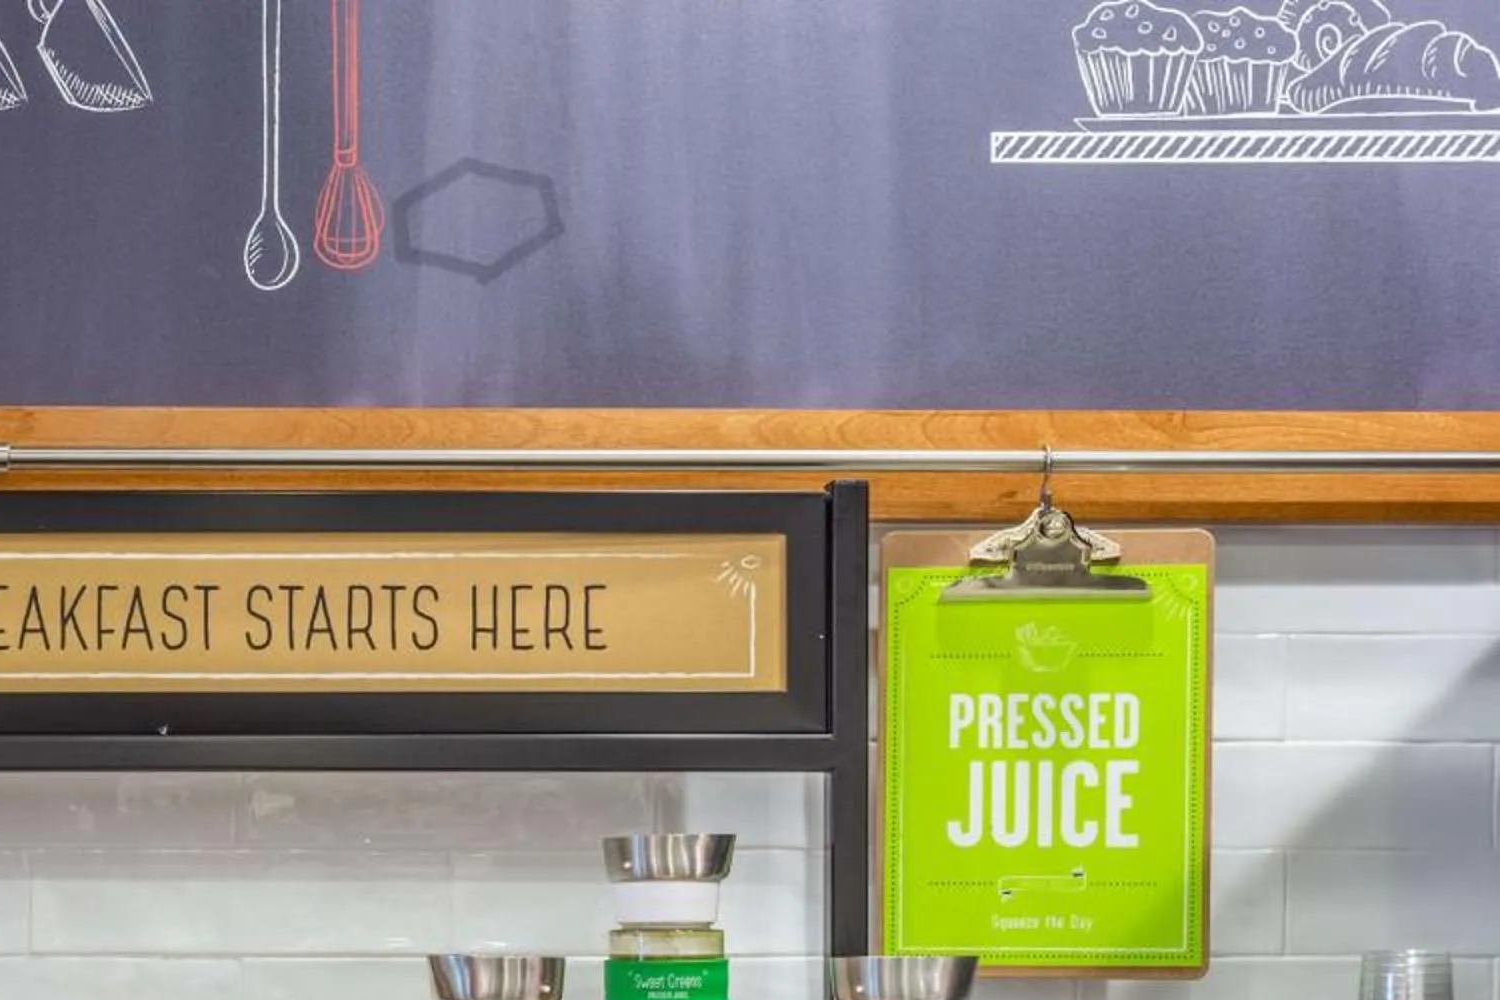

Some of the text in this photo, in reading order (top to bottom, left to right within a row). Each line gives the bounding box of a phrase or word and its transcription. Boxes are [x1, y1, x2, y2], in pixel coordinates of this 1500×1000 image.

[245, 584, 440, 651] STARTS
[471, 584, 608, 651] HERE
[948, 692, 1141, 749] PRESSED
[946, 759, 1140, 848] JUICE
[1068, 912, 1094, 933] Day
